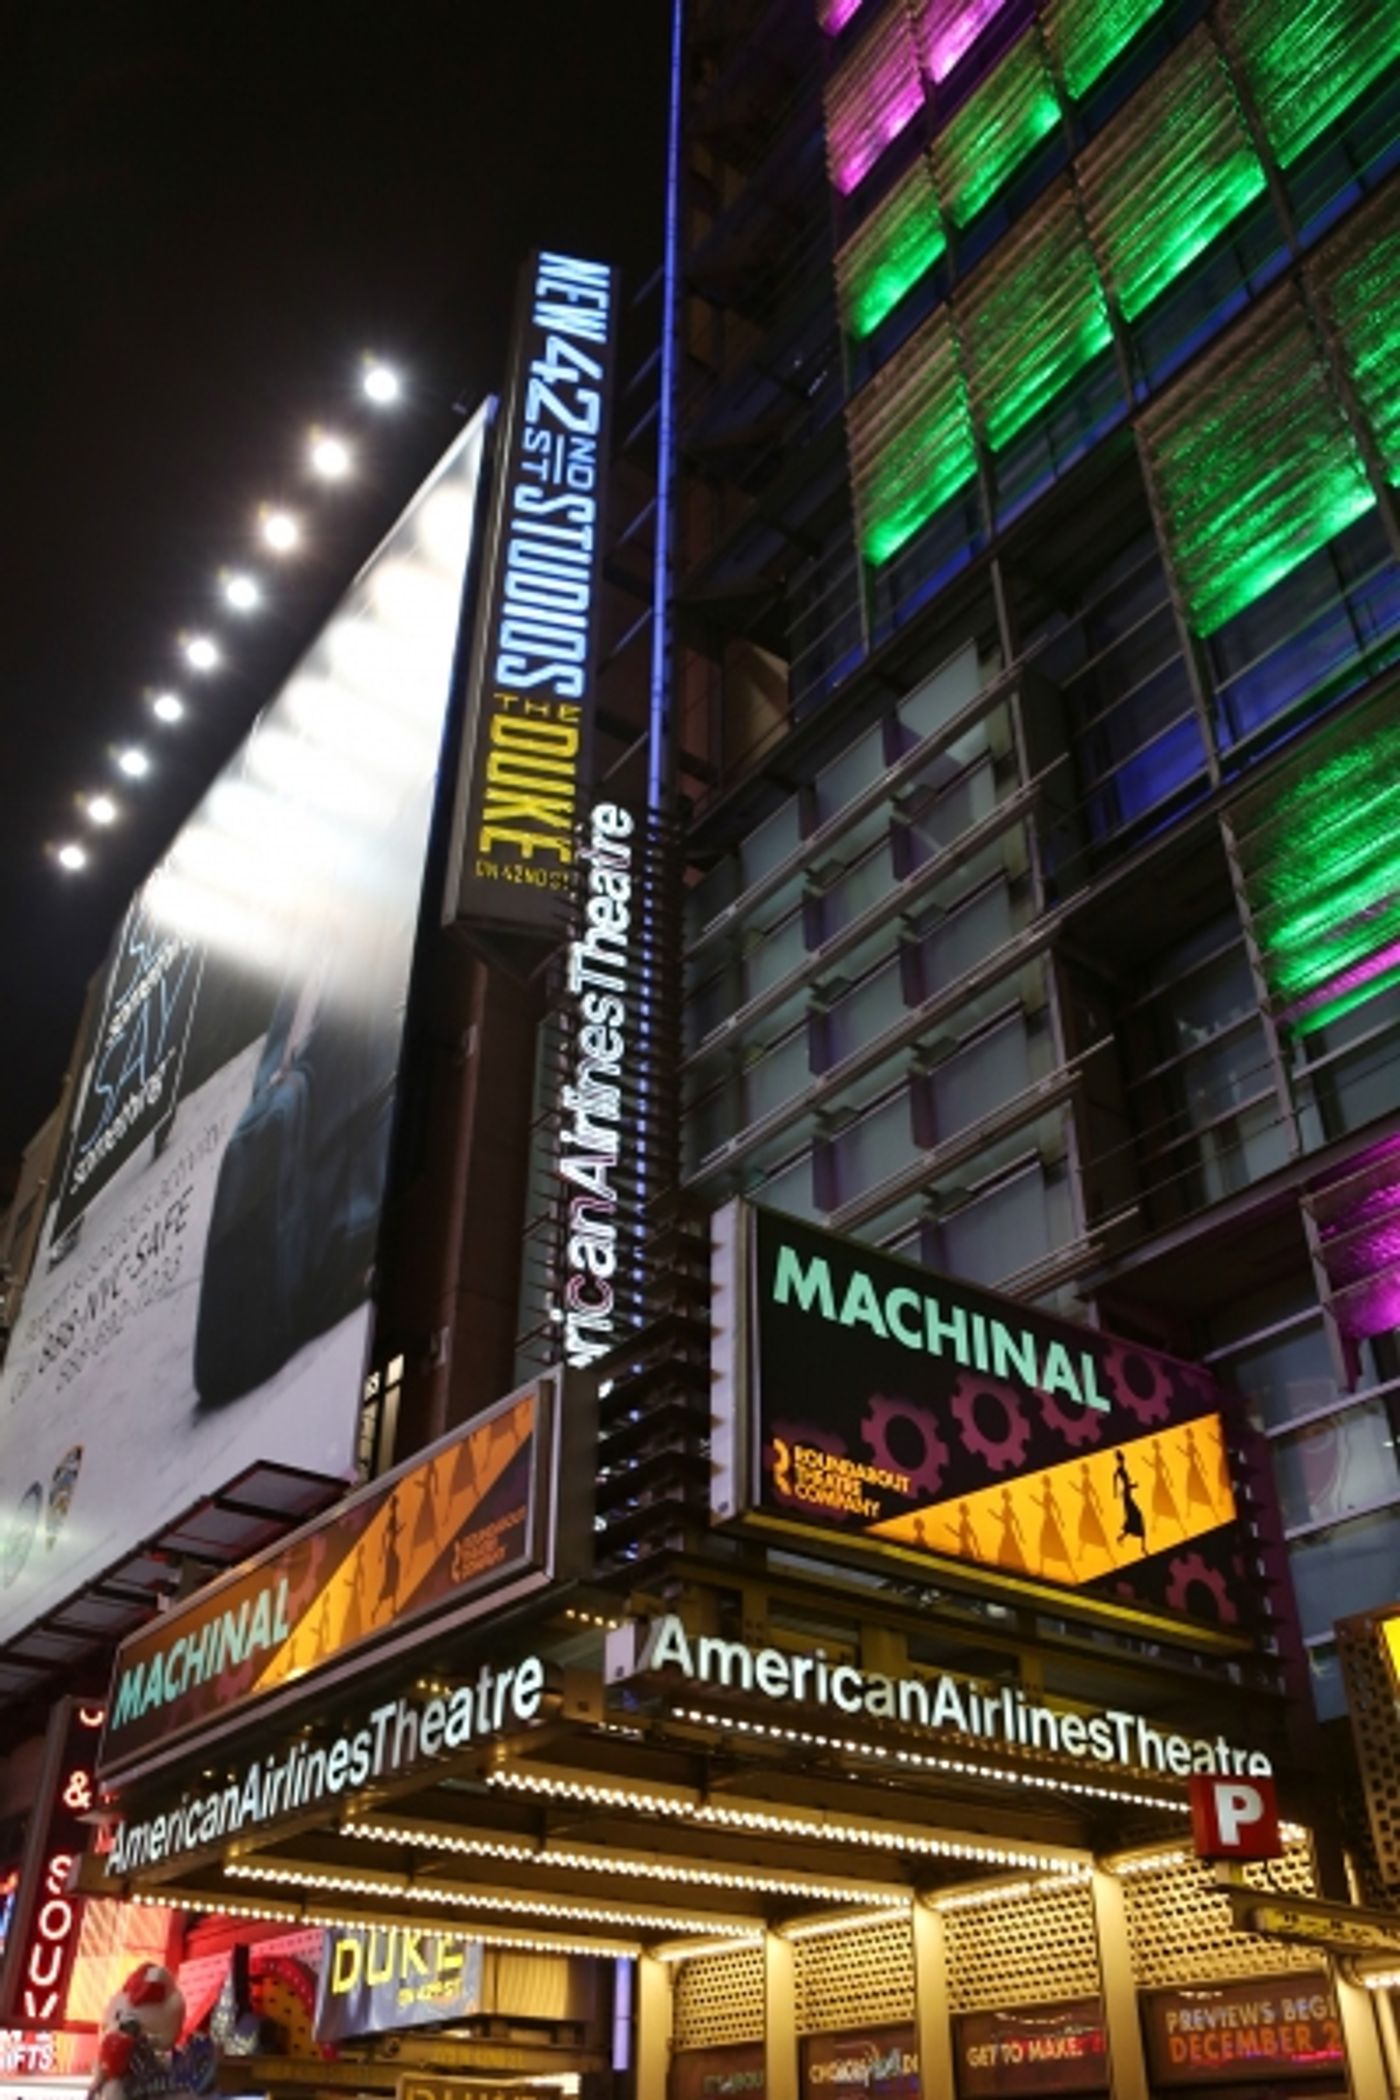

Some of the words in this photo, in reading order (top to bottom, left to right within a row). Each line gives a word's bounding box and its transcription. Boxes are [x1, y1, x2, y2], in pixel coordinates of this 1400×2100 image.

[533, 252, 611, 344] NEW
[496, 484, 596, 698] STUDIOS
[493, 692, 582, 723] THE
[479, 713, 579, 863] DUKE
[773, 1245, 1111, 1413] MACHINAL
[112, 1577, 290, 1731] MACHINAL
[648, 1613, 1274, 1777] AmericanAirlinesTheatre
[104, 1655, 546, 1877] AmericanAirlinesTheatre
[1213, 1783, 1263, 1846] P
[332, 1927, 465, 1995] DUKE
[1165, 2002, 1275, 2034] PREVIEWS
[1168, 2025, 1313, 2064] DECEMBER
